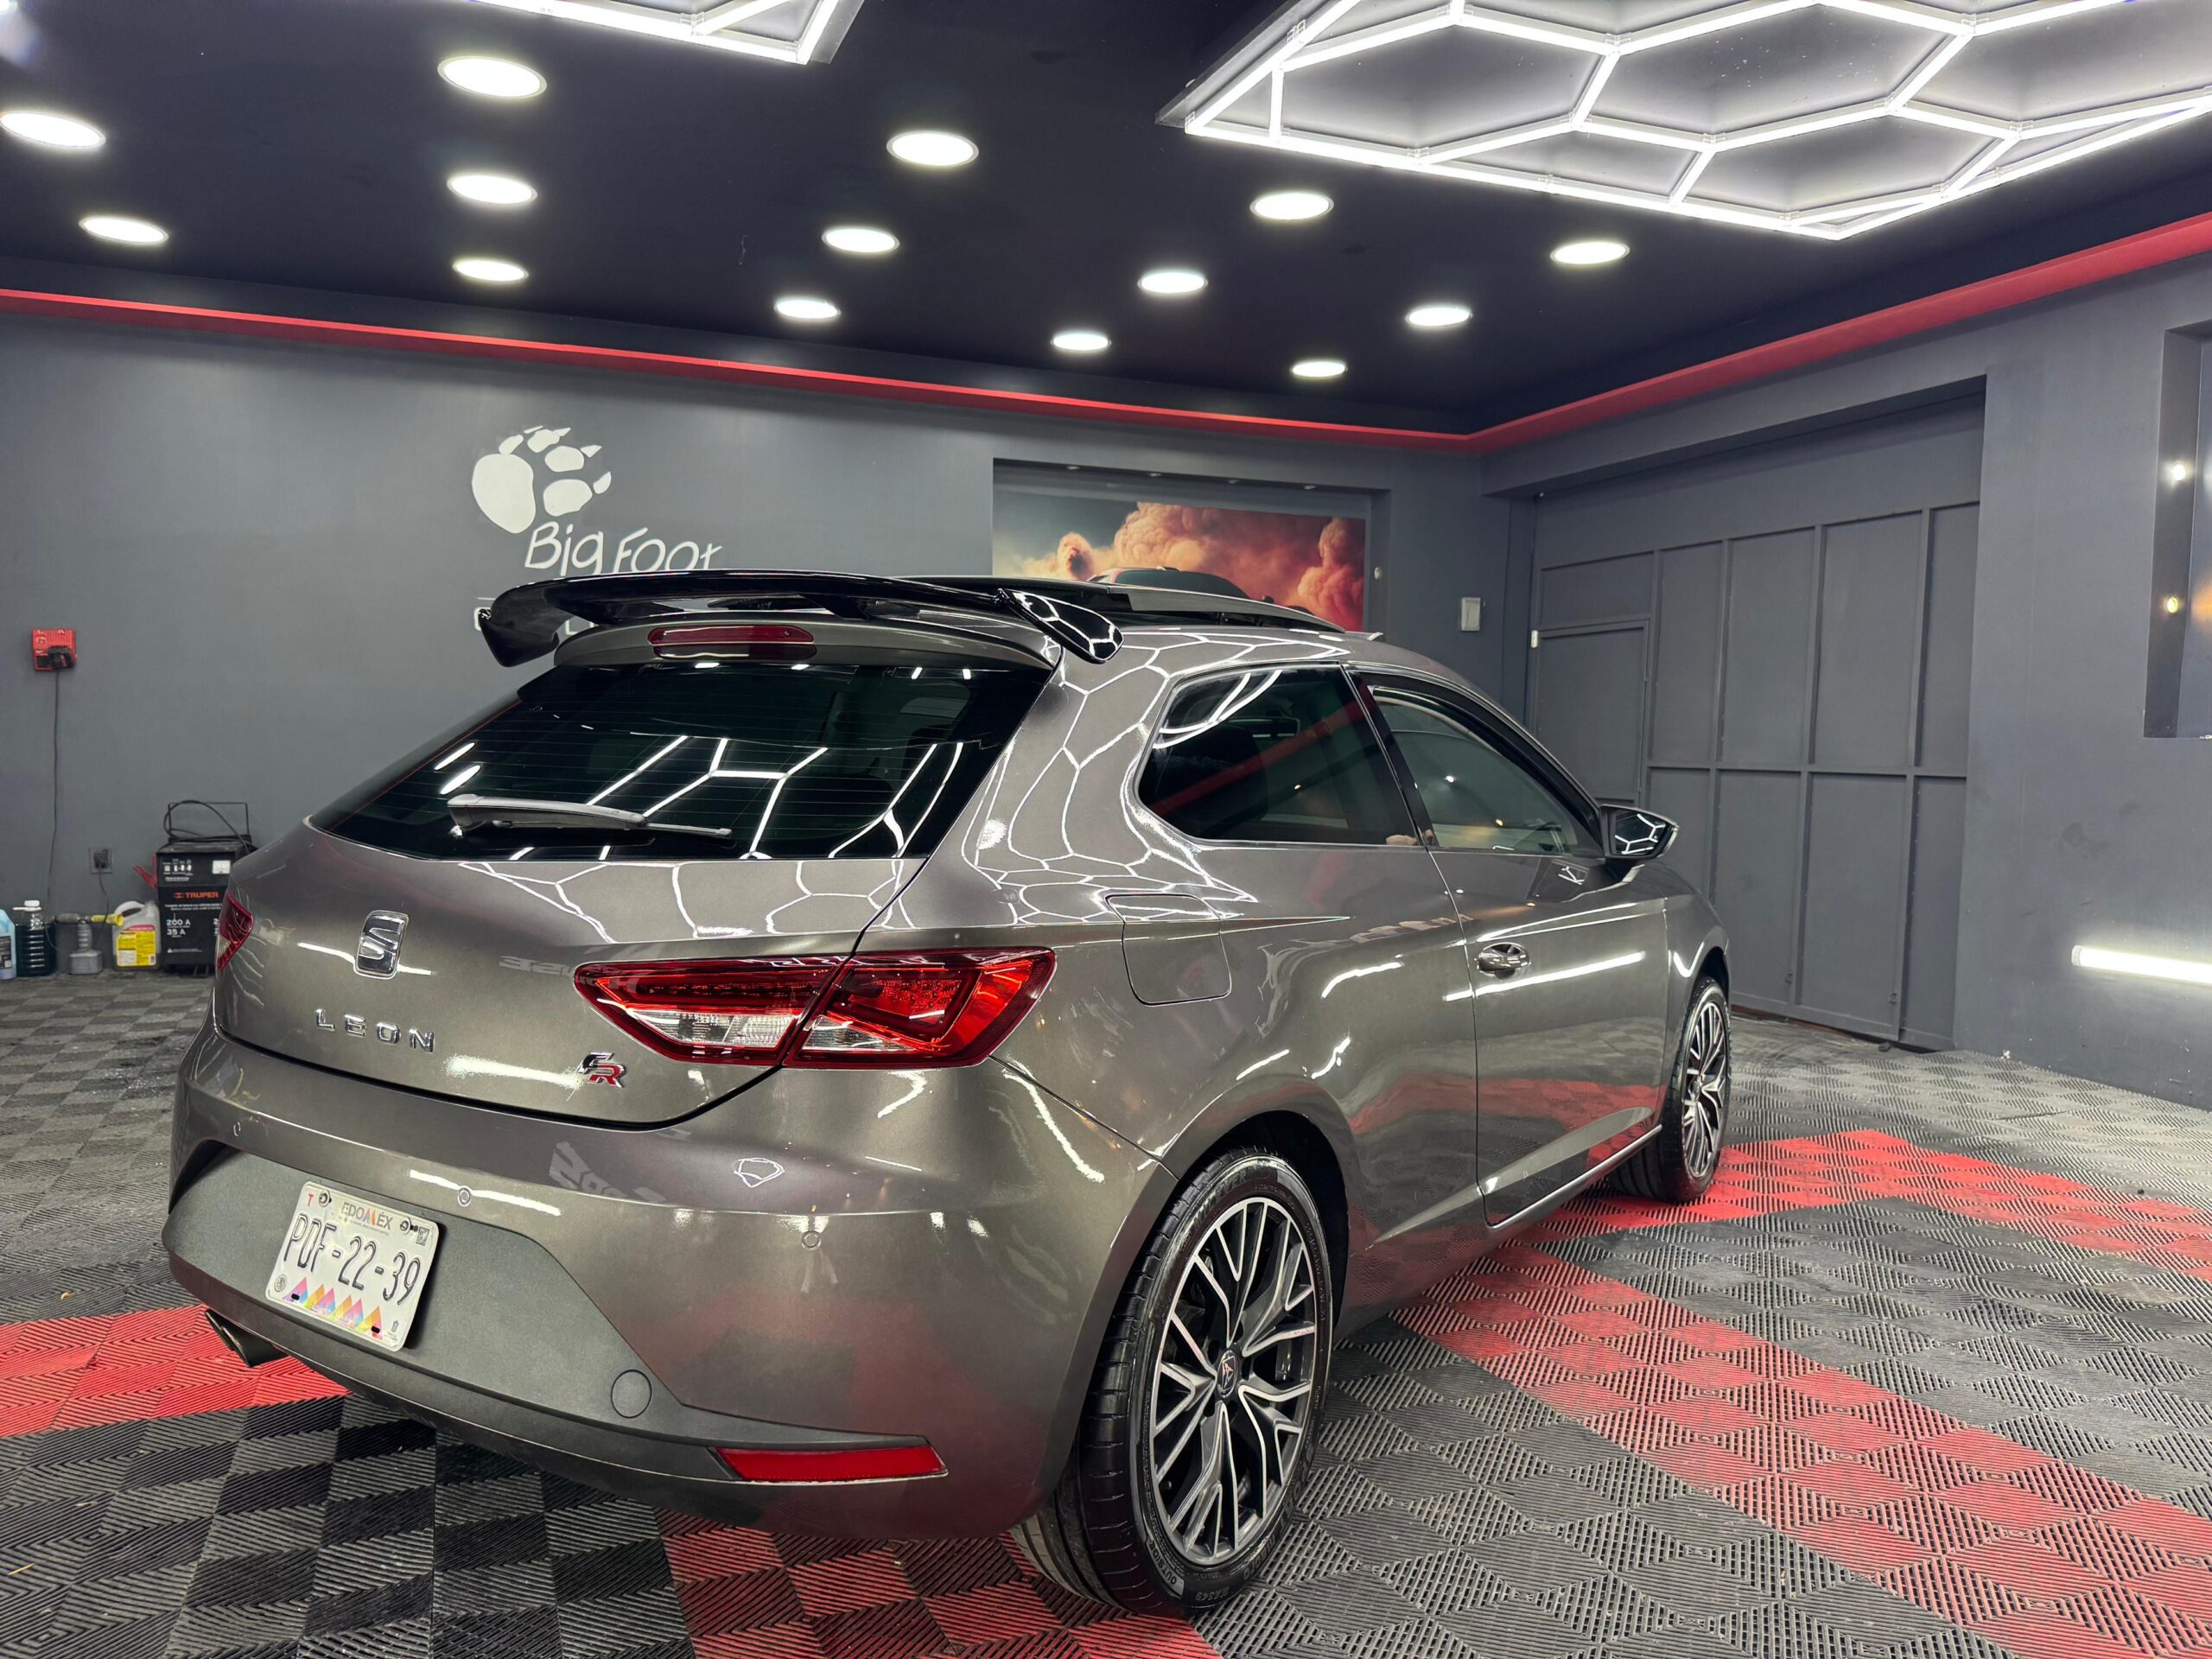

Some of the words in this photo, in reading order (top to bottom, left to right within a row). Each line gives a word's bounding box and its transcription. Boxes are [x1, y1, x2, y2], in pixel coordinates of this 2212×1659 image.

[524, 522, 604, 576] Big
[315, 1008, 435, 1052] LEON
[577, 1052, 626, 1088] FR
[341, 1202, 394, 1231] EDOMÉX
[283, 1212, 421, 1306] PDF-22-39
